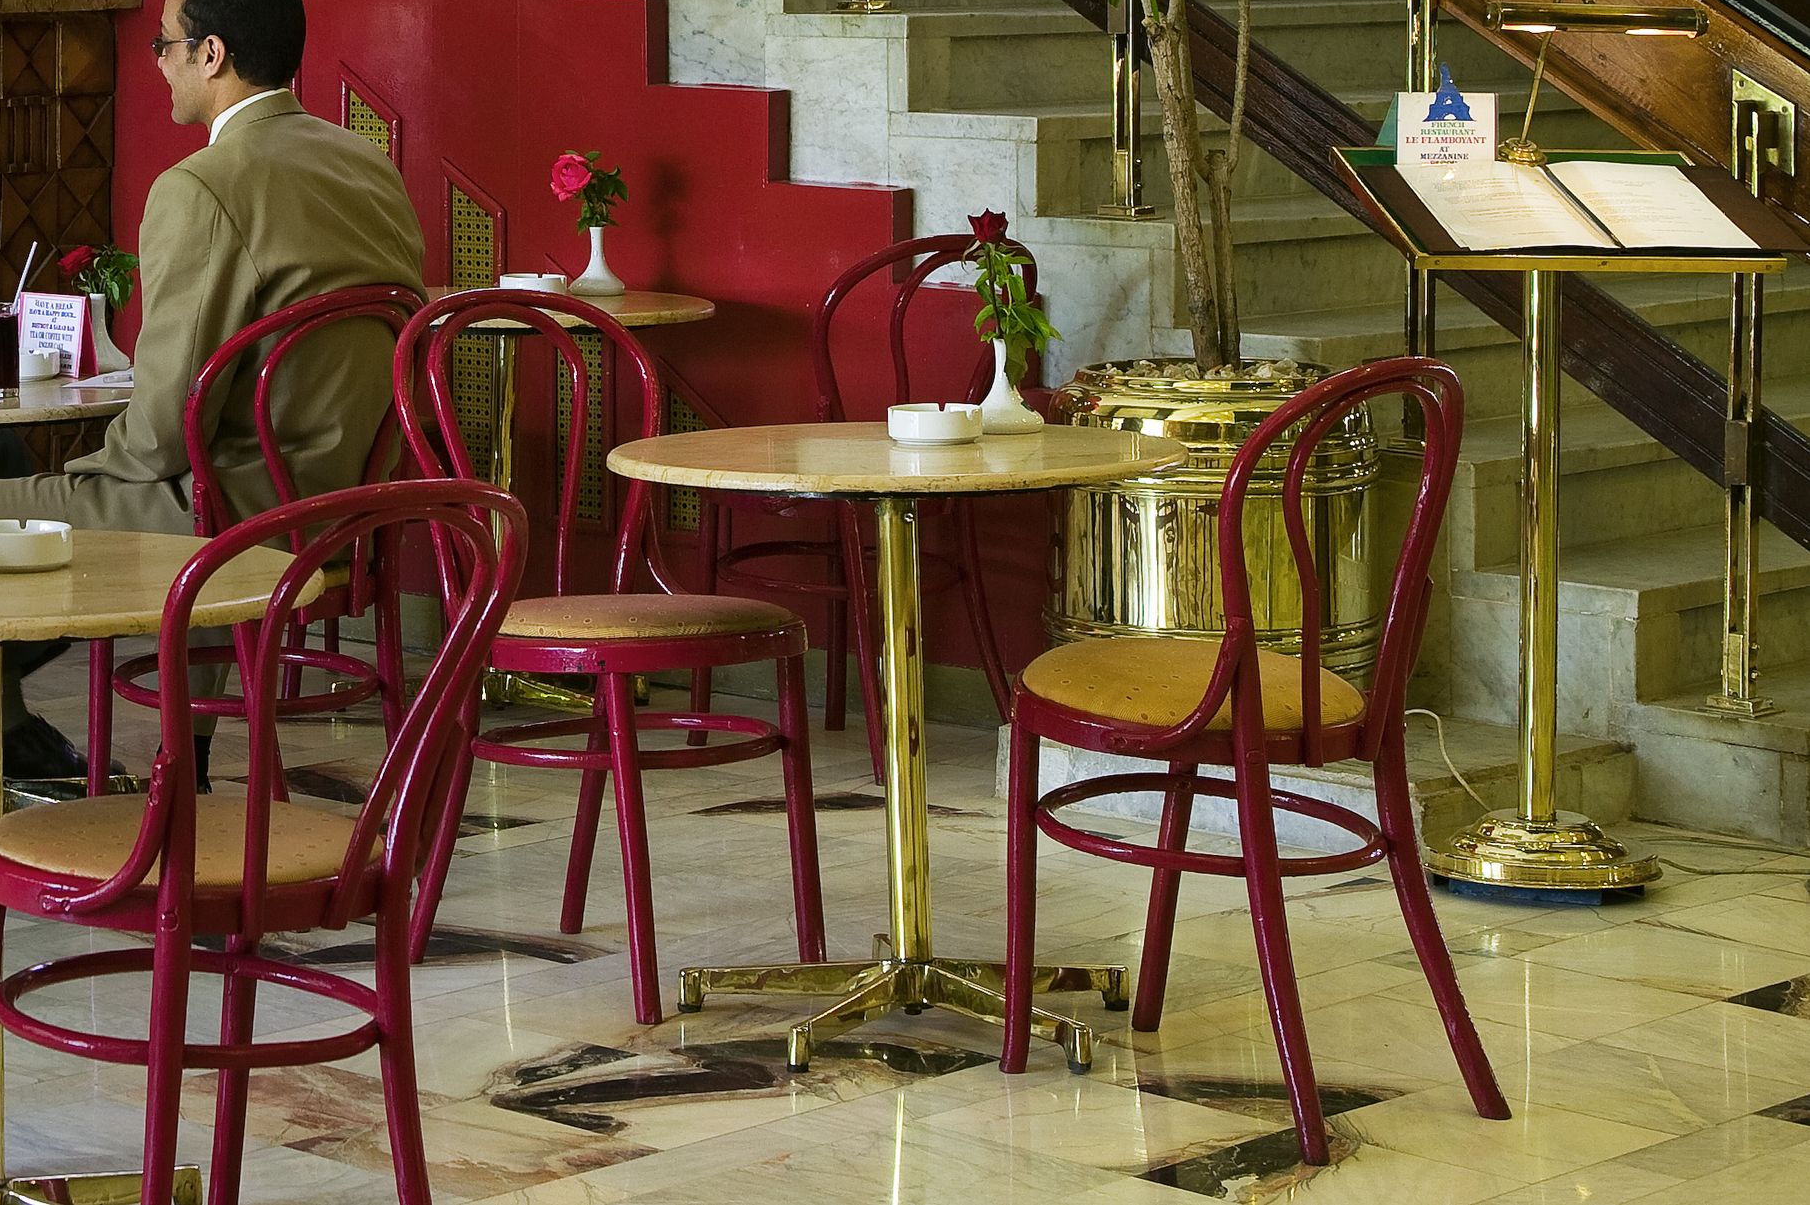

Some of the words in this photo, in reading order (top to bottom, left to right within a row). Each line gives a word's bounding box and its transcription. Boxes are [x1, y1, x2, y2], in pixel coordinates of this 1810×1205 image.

[1420, 128, 1476, 136] RESTAURANT
[1405, 136, 1419, 144] LE
[1421, 136, 1487, 144] FLAMBOYANT
